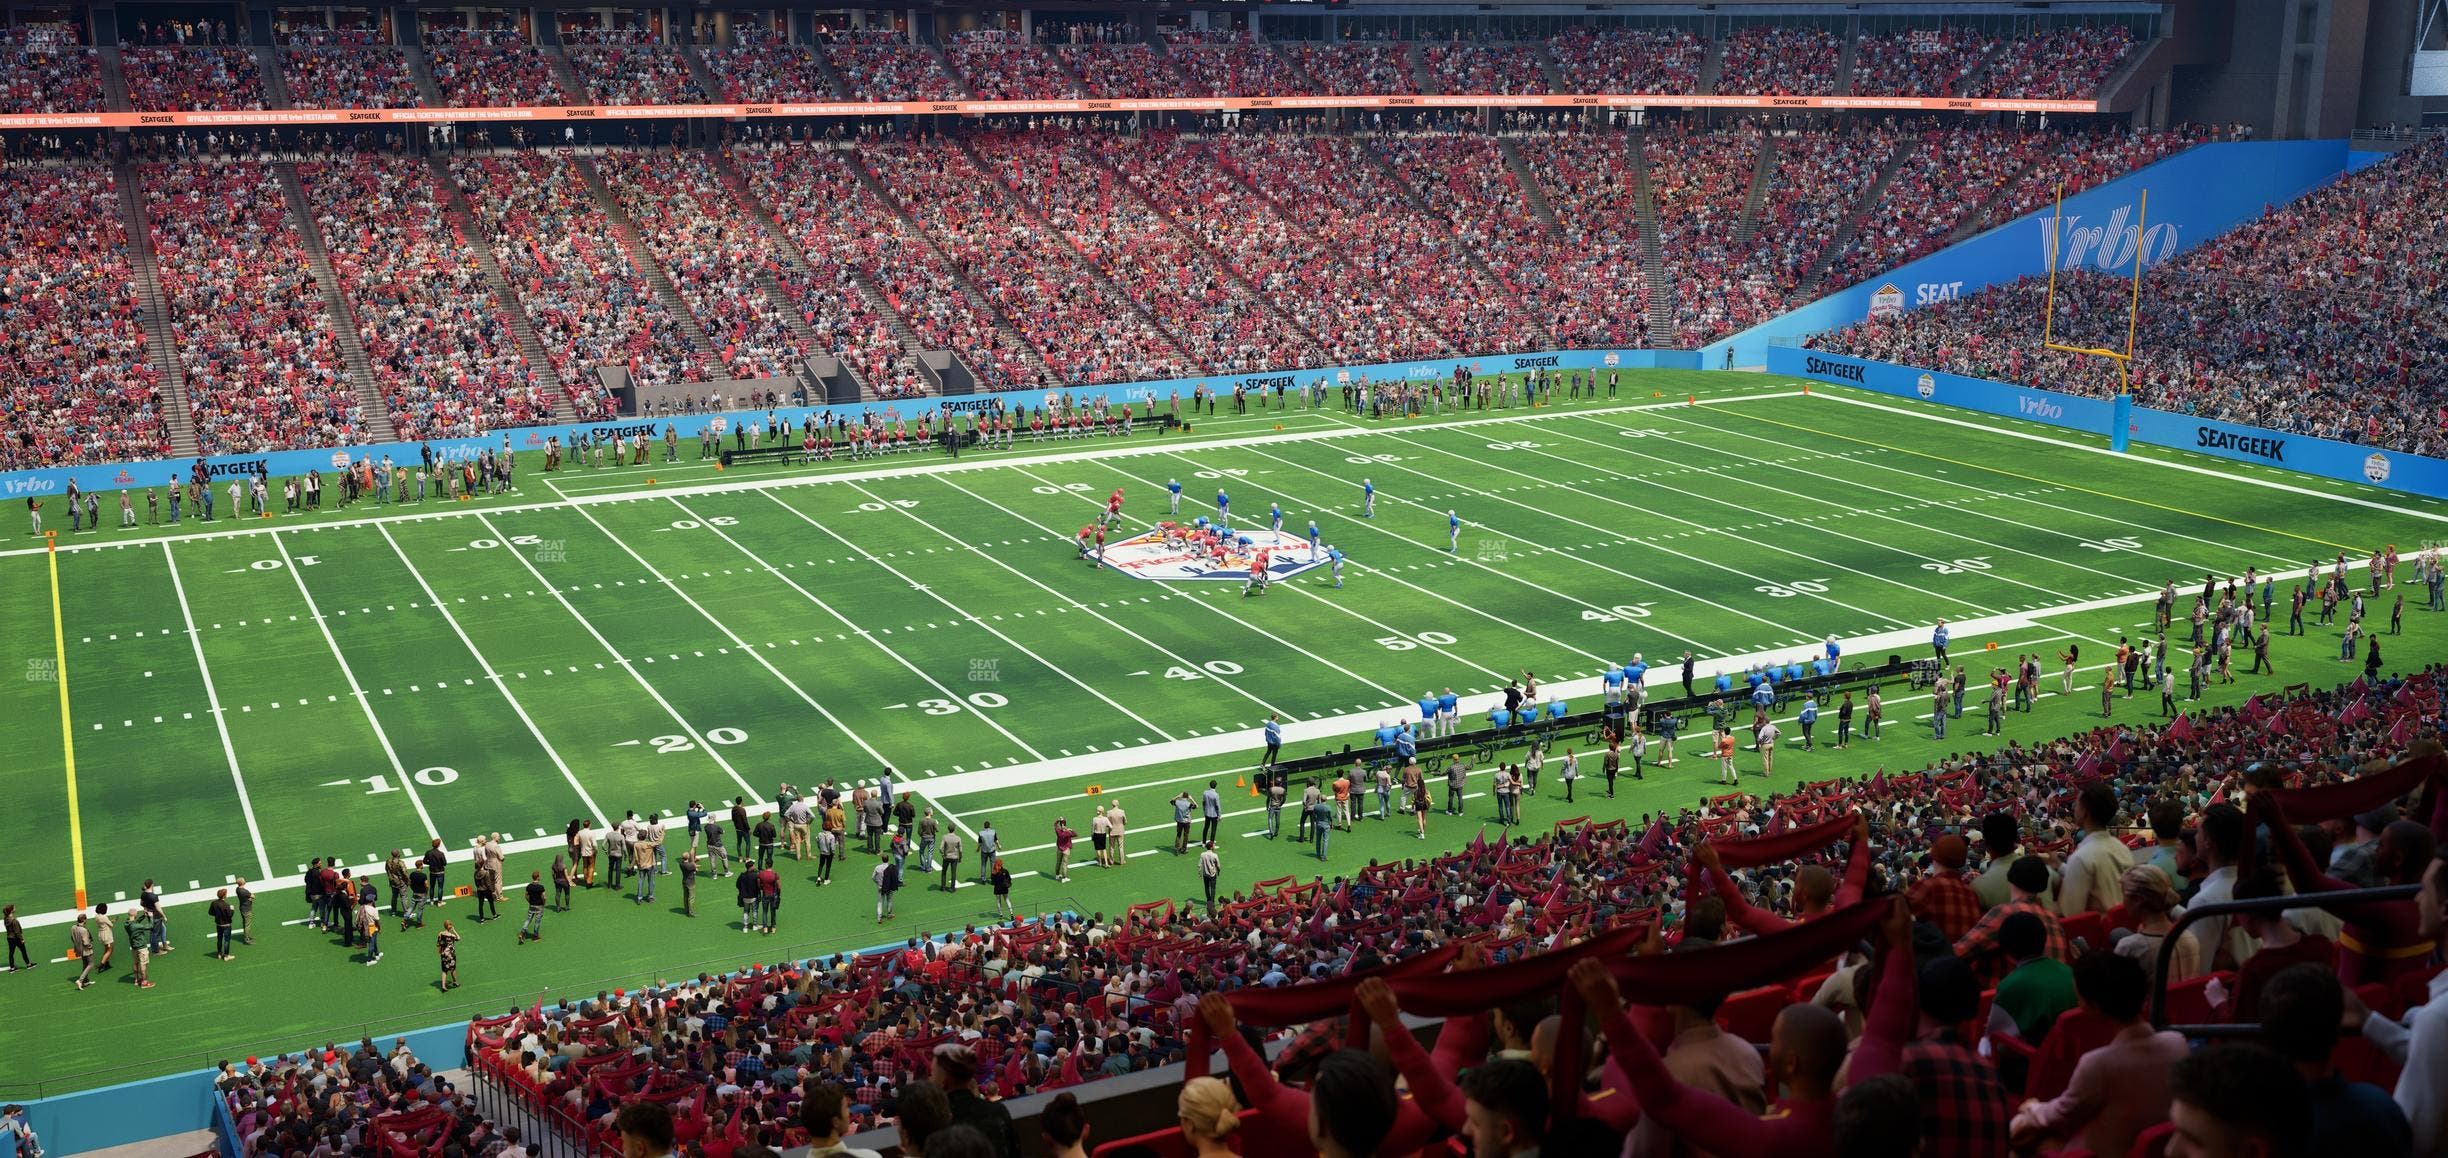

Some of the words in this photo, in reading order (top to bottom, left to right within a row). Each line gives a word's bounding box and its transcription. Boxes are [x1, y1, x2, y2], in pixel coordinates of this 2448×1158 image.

[2039, 205, 2177, 271] Vrbo
[1916, 285, 1963, 306] SEAT
[1515, 355, 1558, 371] SEATGEEK
[1806, 357, 1865, 384] SEATGEEK
[2019, 394, 2062, 420] Vrbo
[440, 443, 483, 459] Vrbo
[2197, 426, 2284, 463] SEATGEEK
[4, 478, 57, 499] Vrbo
[1920, 559, 1993, 575] 20
[1753, 581, 1830, 598] 30
[1581, 605, 1652, 623] 40
[1373, 631, 1458, 651] 50
[1163, 660, 1245, 681] 40
[917, 692, 1009, 716] 30
[649, 727, 749, 754] 20
[360, 766, 460, 796] 10
[1090, 786, 1099, 795] 30
[459, 887, 469, 896] 10
